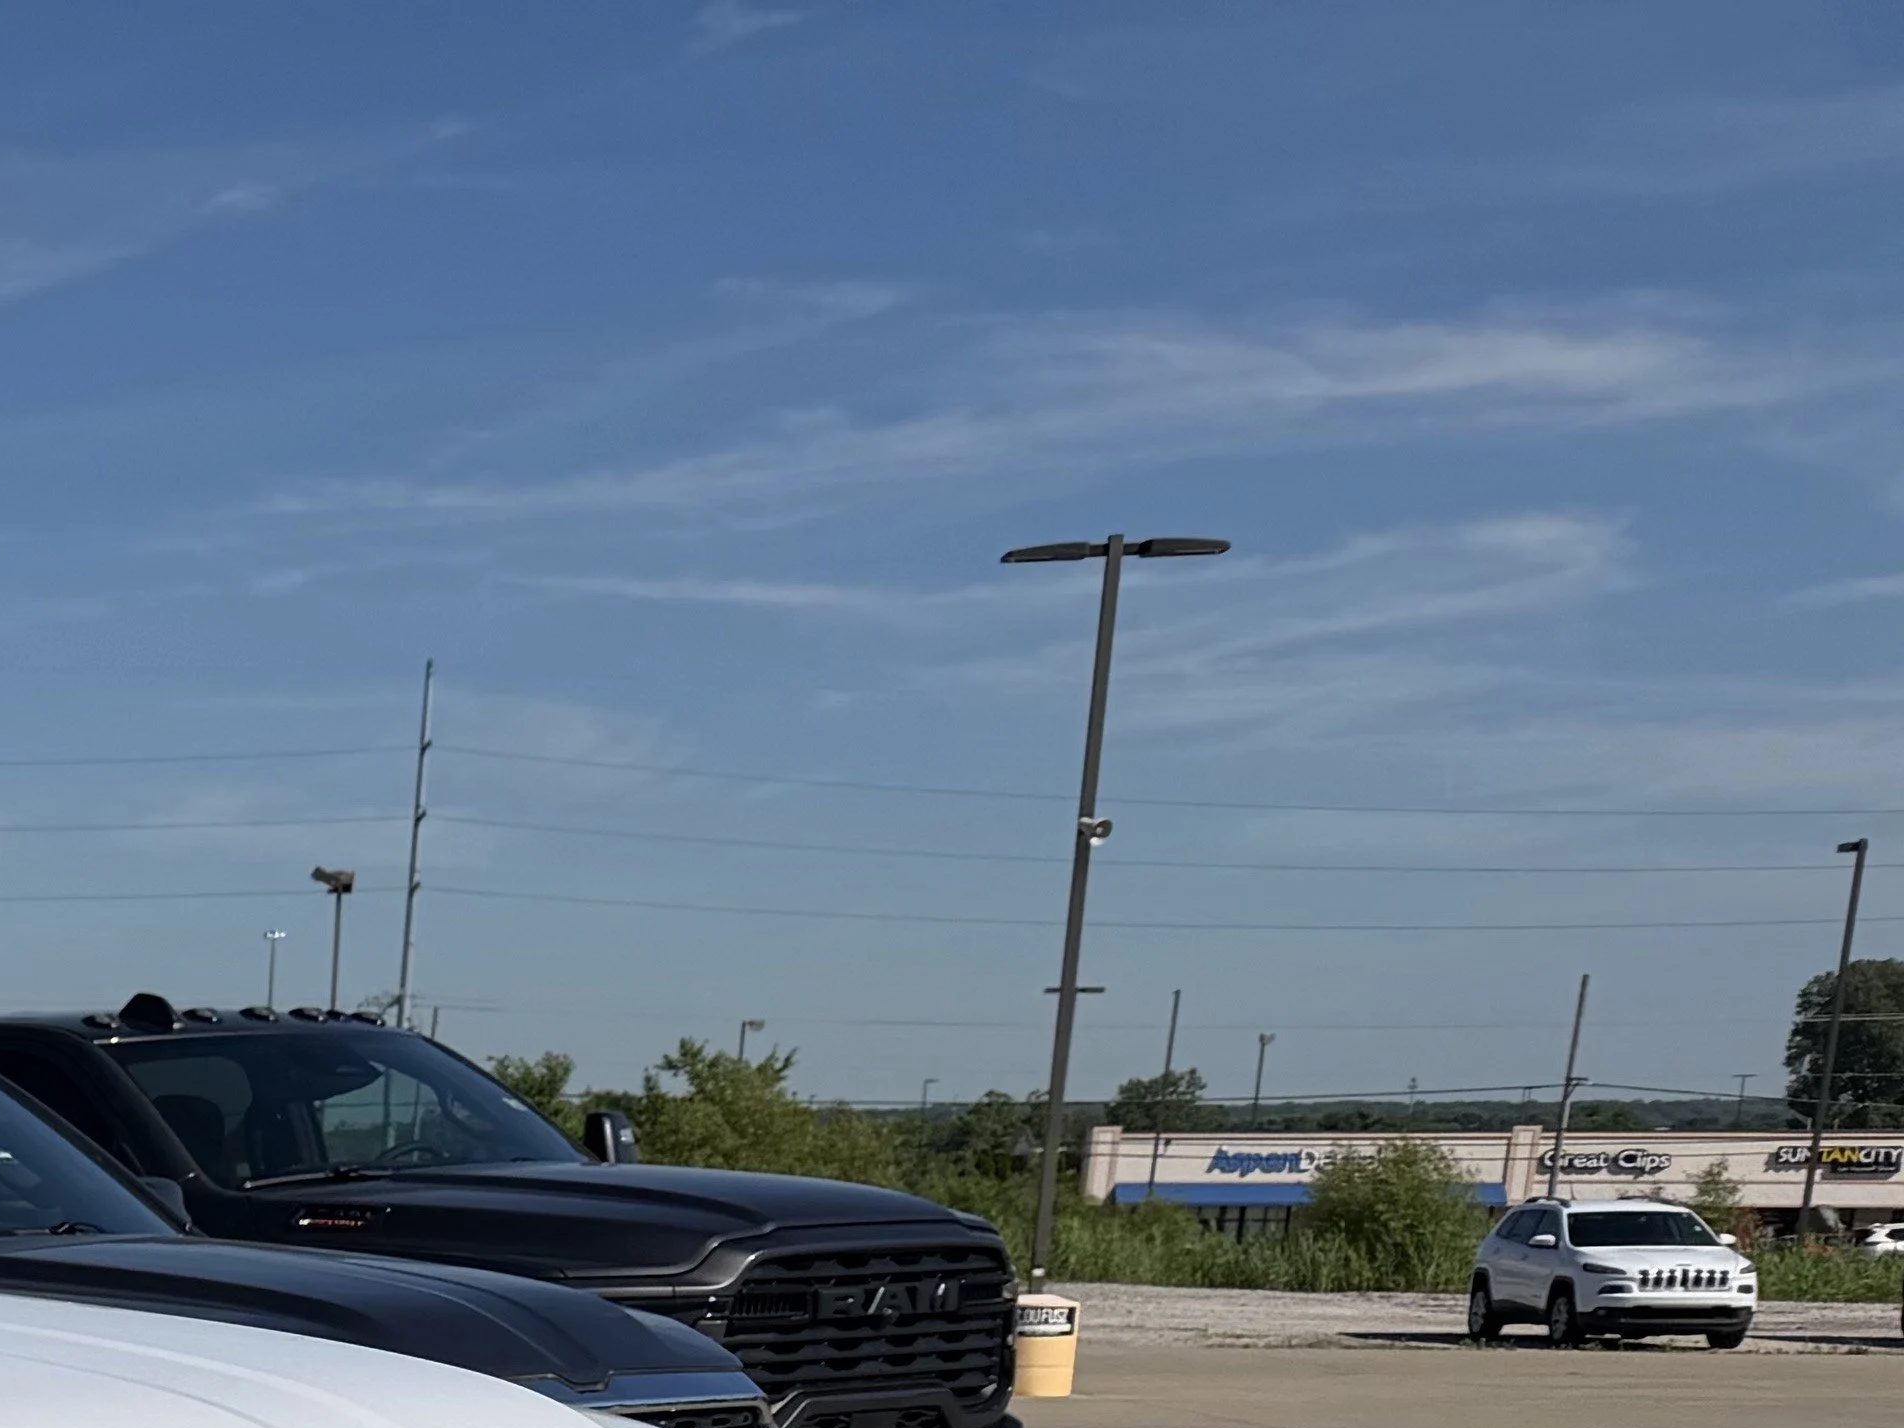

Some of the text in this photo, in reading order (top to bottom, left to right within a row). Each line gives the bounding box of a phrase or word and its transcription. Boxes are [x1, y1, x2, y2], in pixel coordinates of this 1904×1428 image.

[1205, 1145, 1311, 1178] Aspen
[1543, 1149, 1671, 1172] Great Clips
